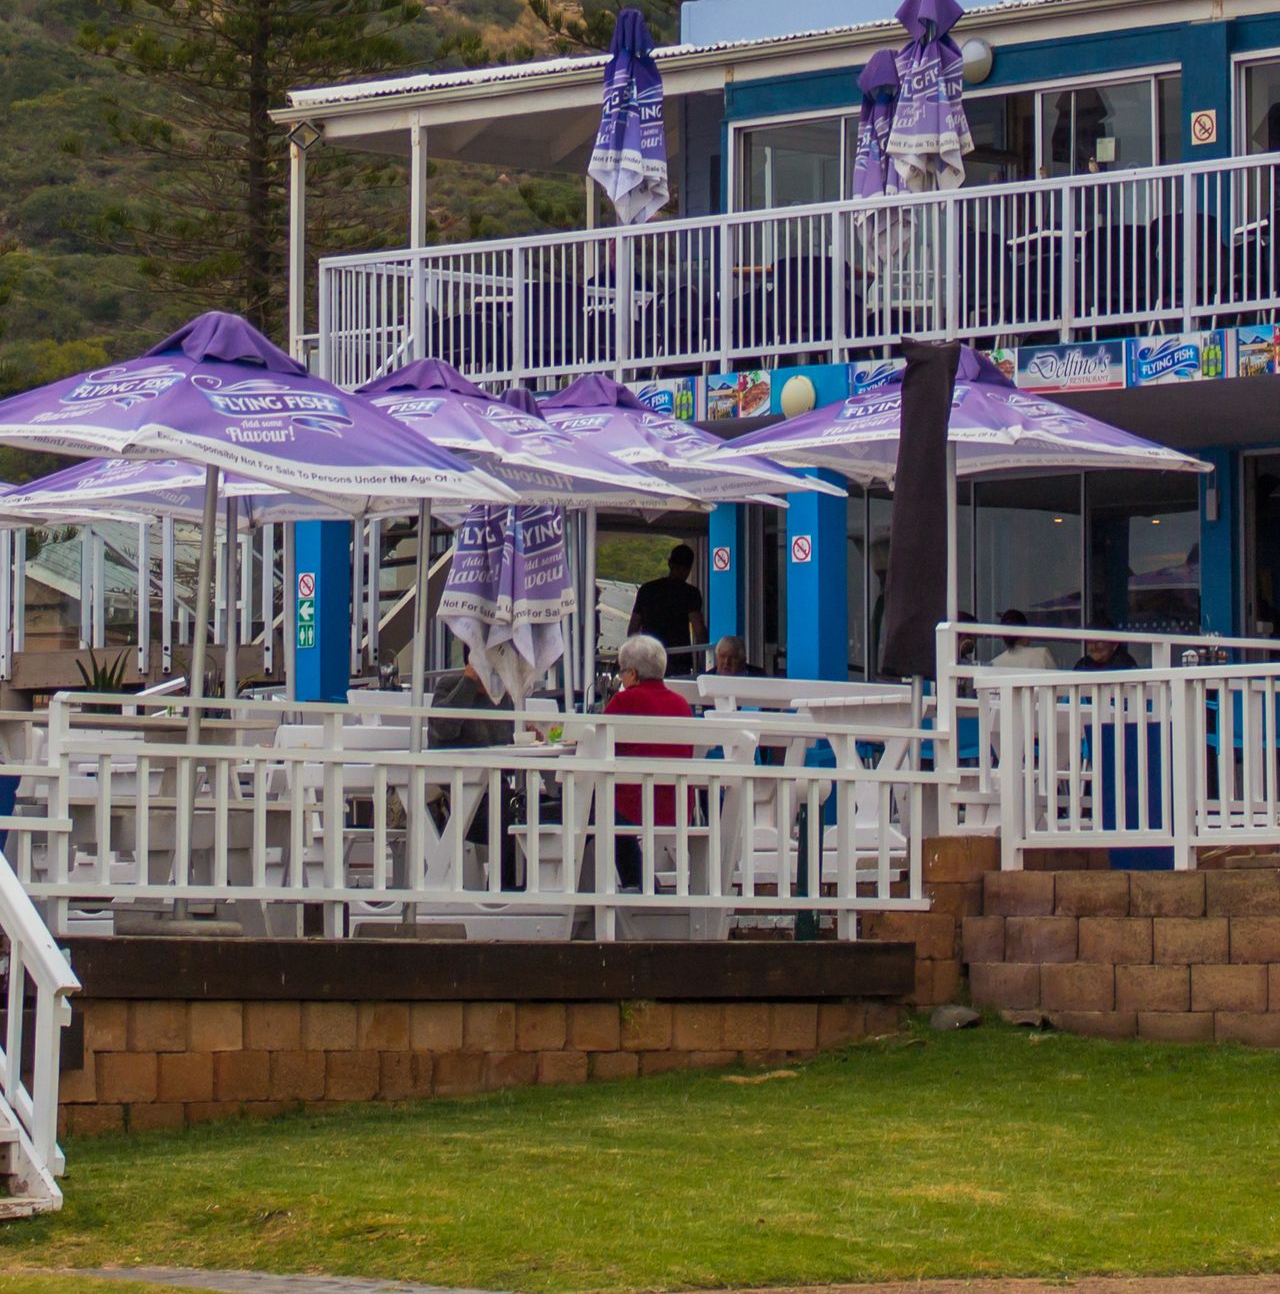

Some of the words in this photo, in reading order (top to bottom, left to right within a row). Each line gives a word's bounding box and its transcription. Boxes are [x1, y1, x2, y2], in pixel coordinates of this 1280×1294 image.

[1030, 345, 1111, 387] Delfino's
[1140, 355, 1173, 375] FLYING
[1174, 347, 1195, 364] FISH
[71, 380, 136, 398] FLYING
[137, 375, 177, 390] FISH
[1069, 374, 1109, 385] RESTAURANT
[213, 396, 283, 411] FLYING
[283, 396, 338, 411] FISH
[387, 400, 436, 414] FISH
[651, 393, 670, 407] FISH
[845, 400, 901, 418] FLYIN
[241, 420, 260, 428] Add
[261, 420, 284, 428] some
[560, 417, 606, 430] FISH
[225, 425, 296, 443] Flavour!
[185, 437, 240, 464] Responsibly
[240, 455, 257, 467] Not
[258, 459, 274, 473] For
[275, 463, 295, 477] Sale
[297, 469, 310, 479] To
[311, 472, 353, 484] Persons
[354, 475, 387, 484] Under
[389, 474, 408, 484] the
[410, 474, 432, 485] Age
[434, 474, 448, 483] Of
[443, 599, 459, 609] Not
[461, 600, 478, 612] For
[544, 608, 560, 618] Sal
